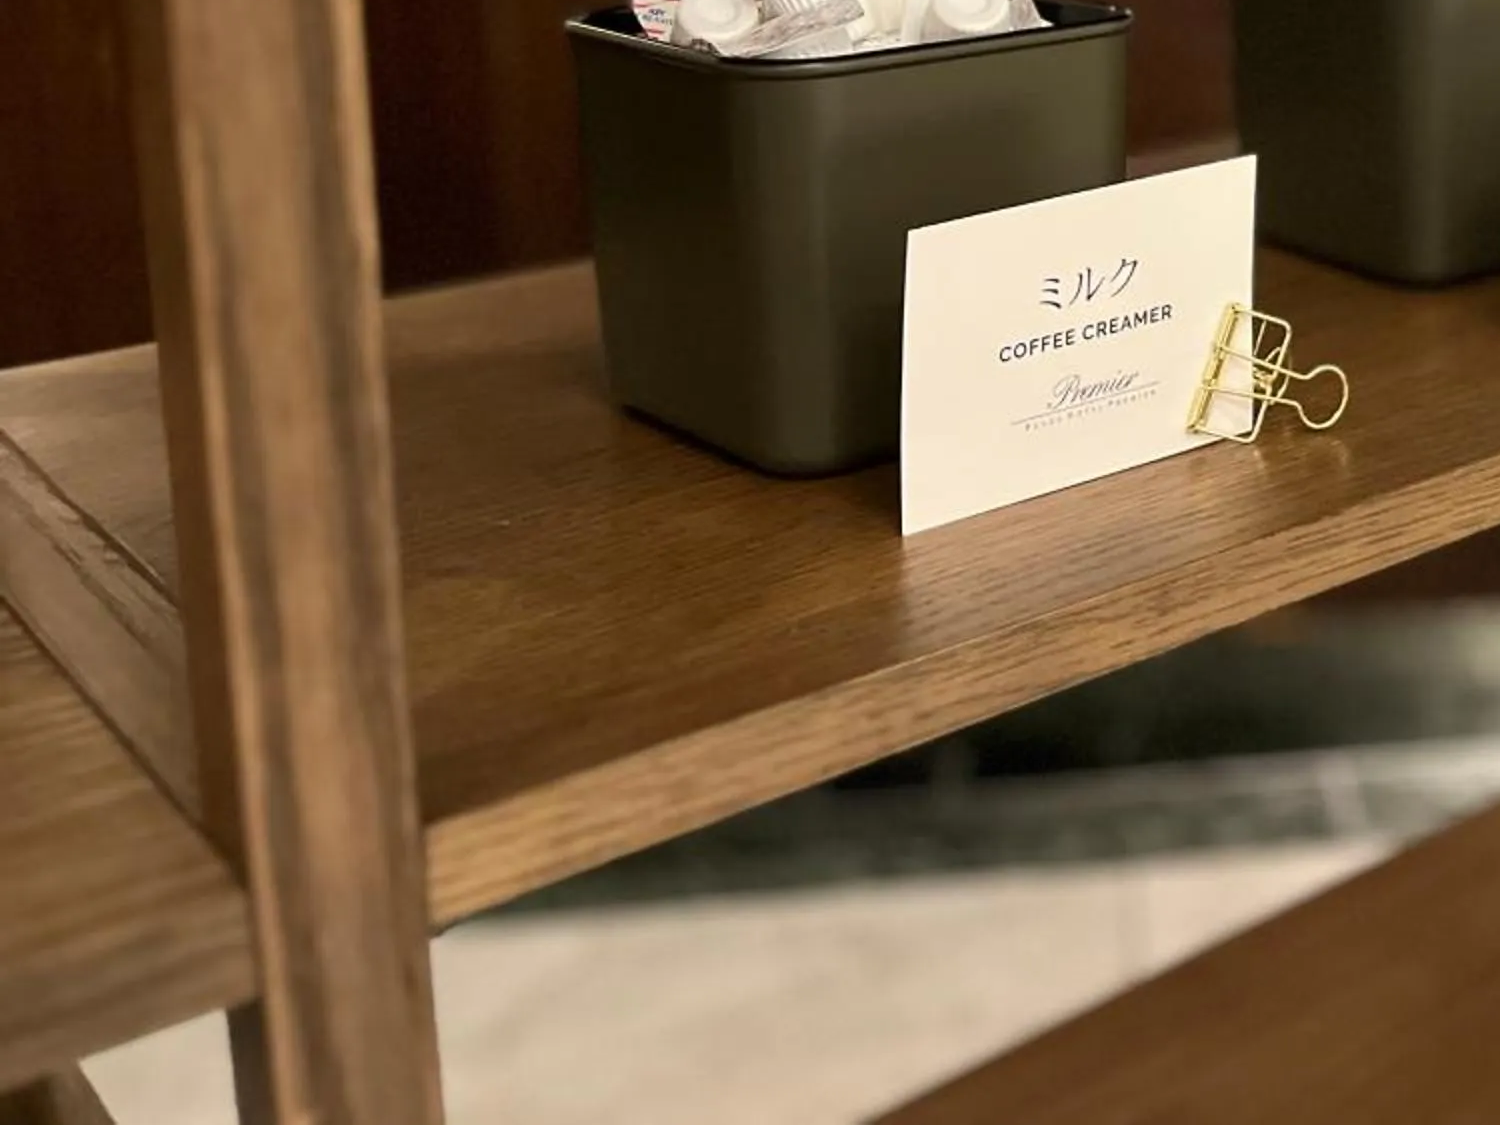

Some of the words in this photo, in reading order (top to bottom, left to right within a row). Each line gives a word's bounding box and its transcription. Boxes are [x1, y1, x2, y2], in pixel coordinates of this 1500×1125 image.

[1039, 258, 1138, 309] ミルク
[999, 328, 1076, 363] COFFEE
[1082, 303, 1174, 341] CREAMER
[1047, 369, 1140, 409] Premier
